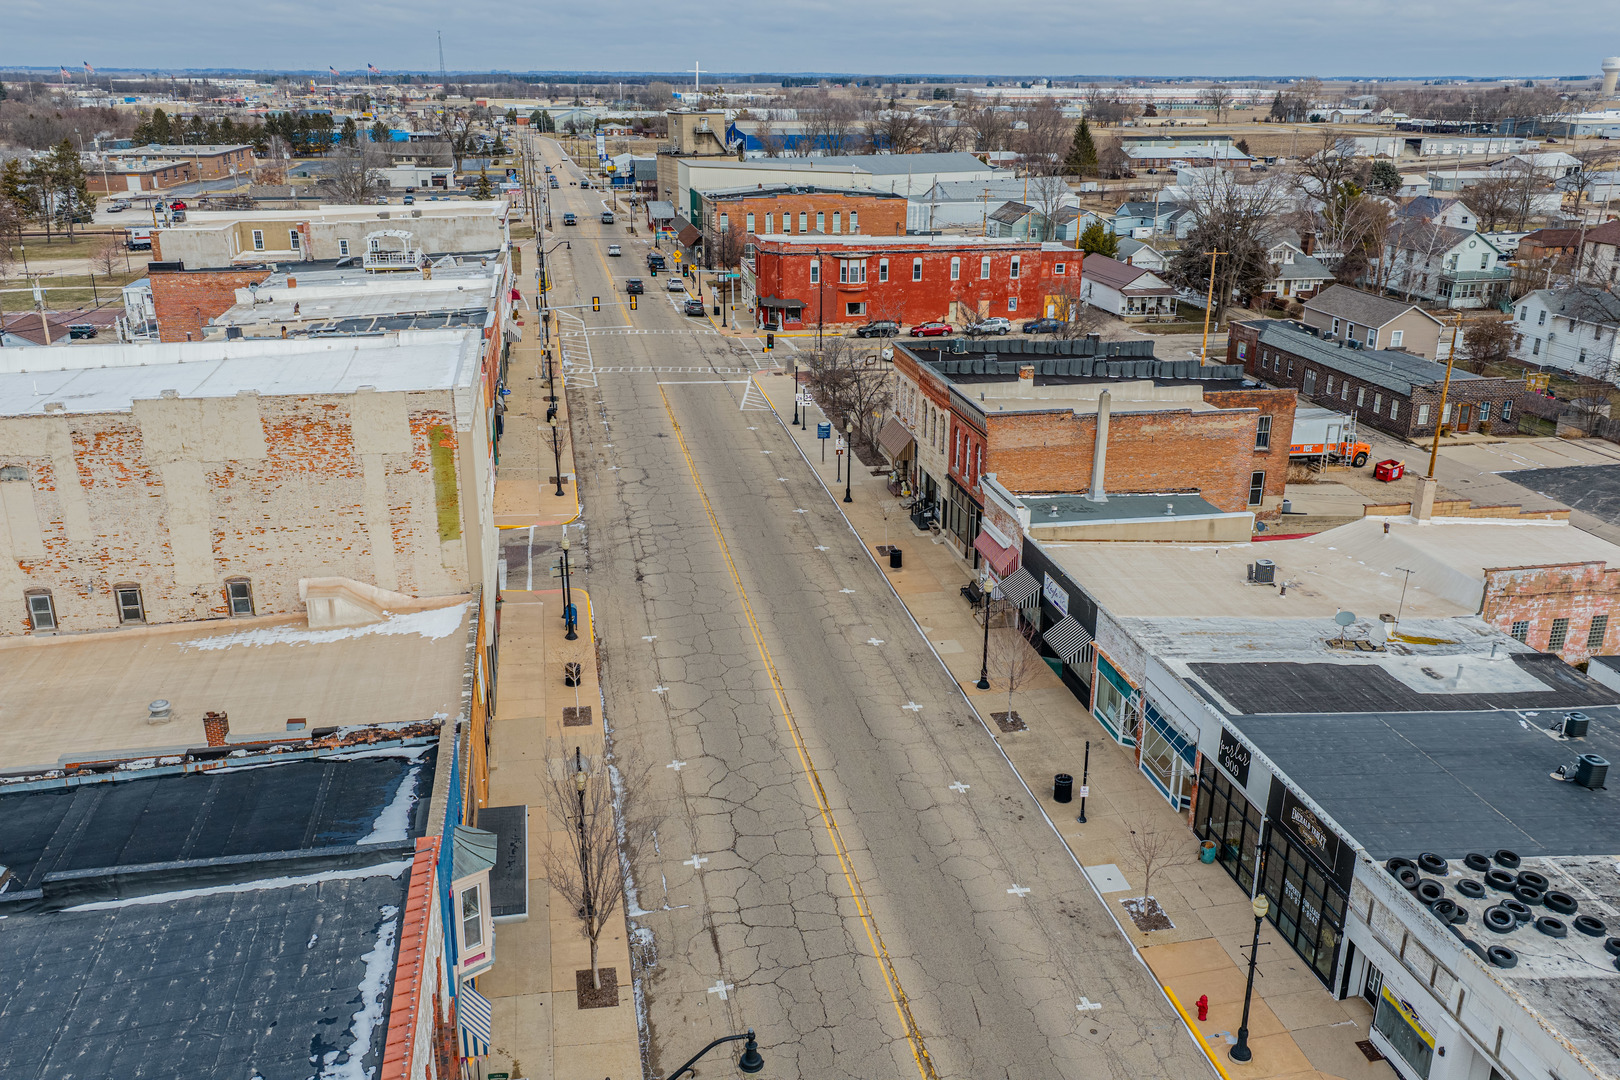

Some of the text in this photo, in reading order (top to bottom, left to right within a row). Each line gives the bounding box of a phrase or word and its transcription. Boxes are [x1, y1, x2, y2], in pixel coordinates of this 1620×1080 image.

[1303, 445, 1314, 453] ICE
[1220, 740, 1250, 766] parlor
[1225, 756, 1239, 777] 909
